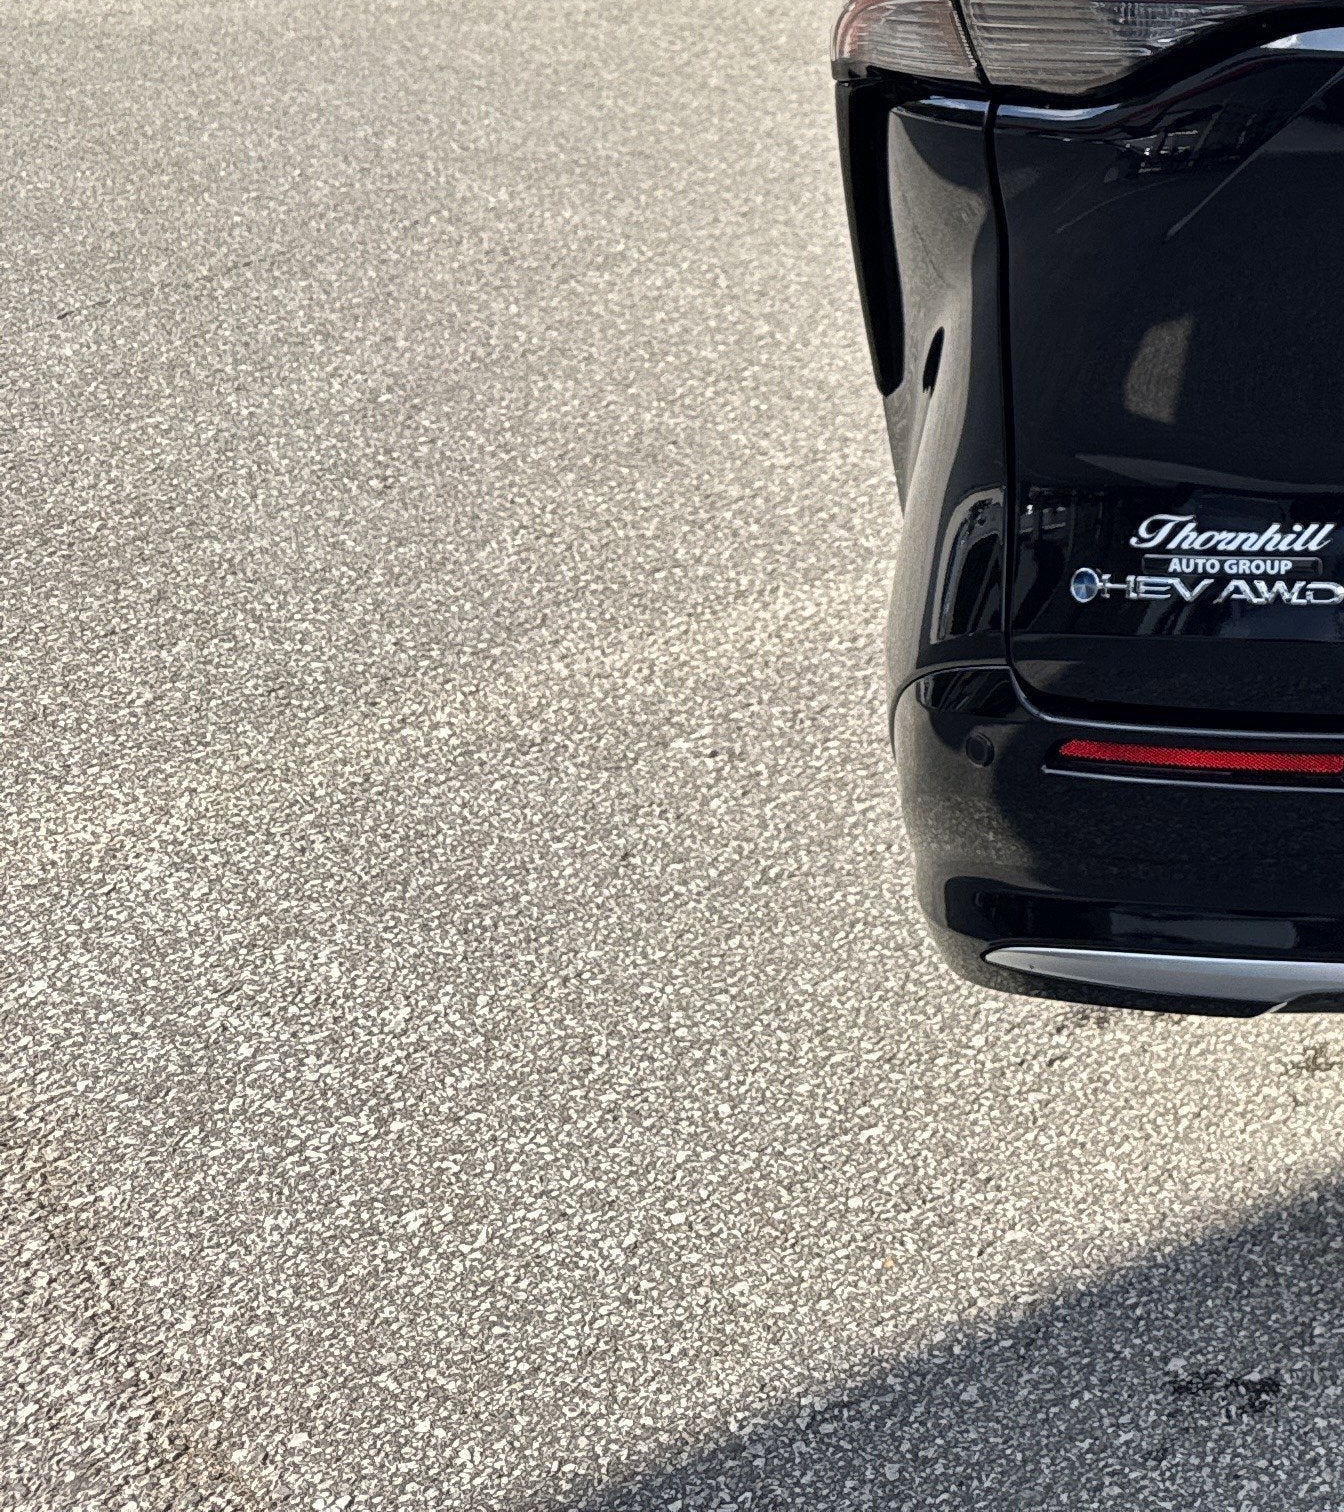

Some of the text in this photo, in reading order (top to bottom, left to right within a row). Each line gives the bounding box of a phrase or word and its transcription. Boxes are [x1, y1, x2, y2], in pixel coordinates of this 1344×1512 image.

[1129, 513, 1336, 552] Thornhill
[1168, 557, 1293, 575] AUTO GROUP
[1101, 573, 1215, 603] HEV
